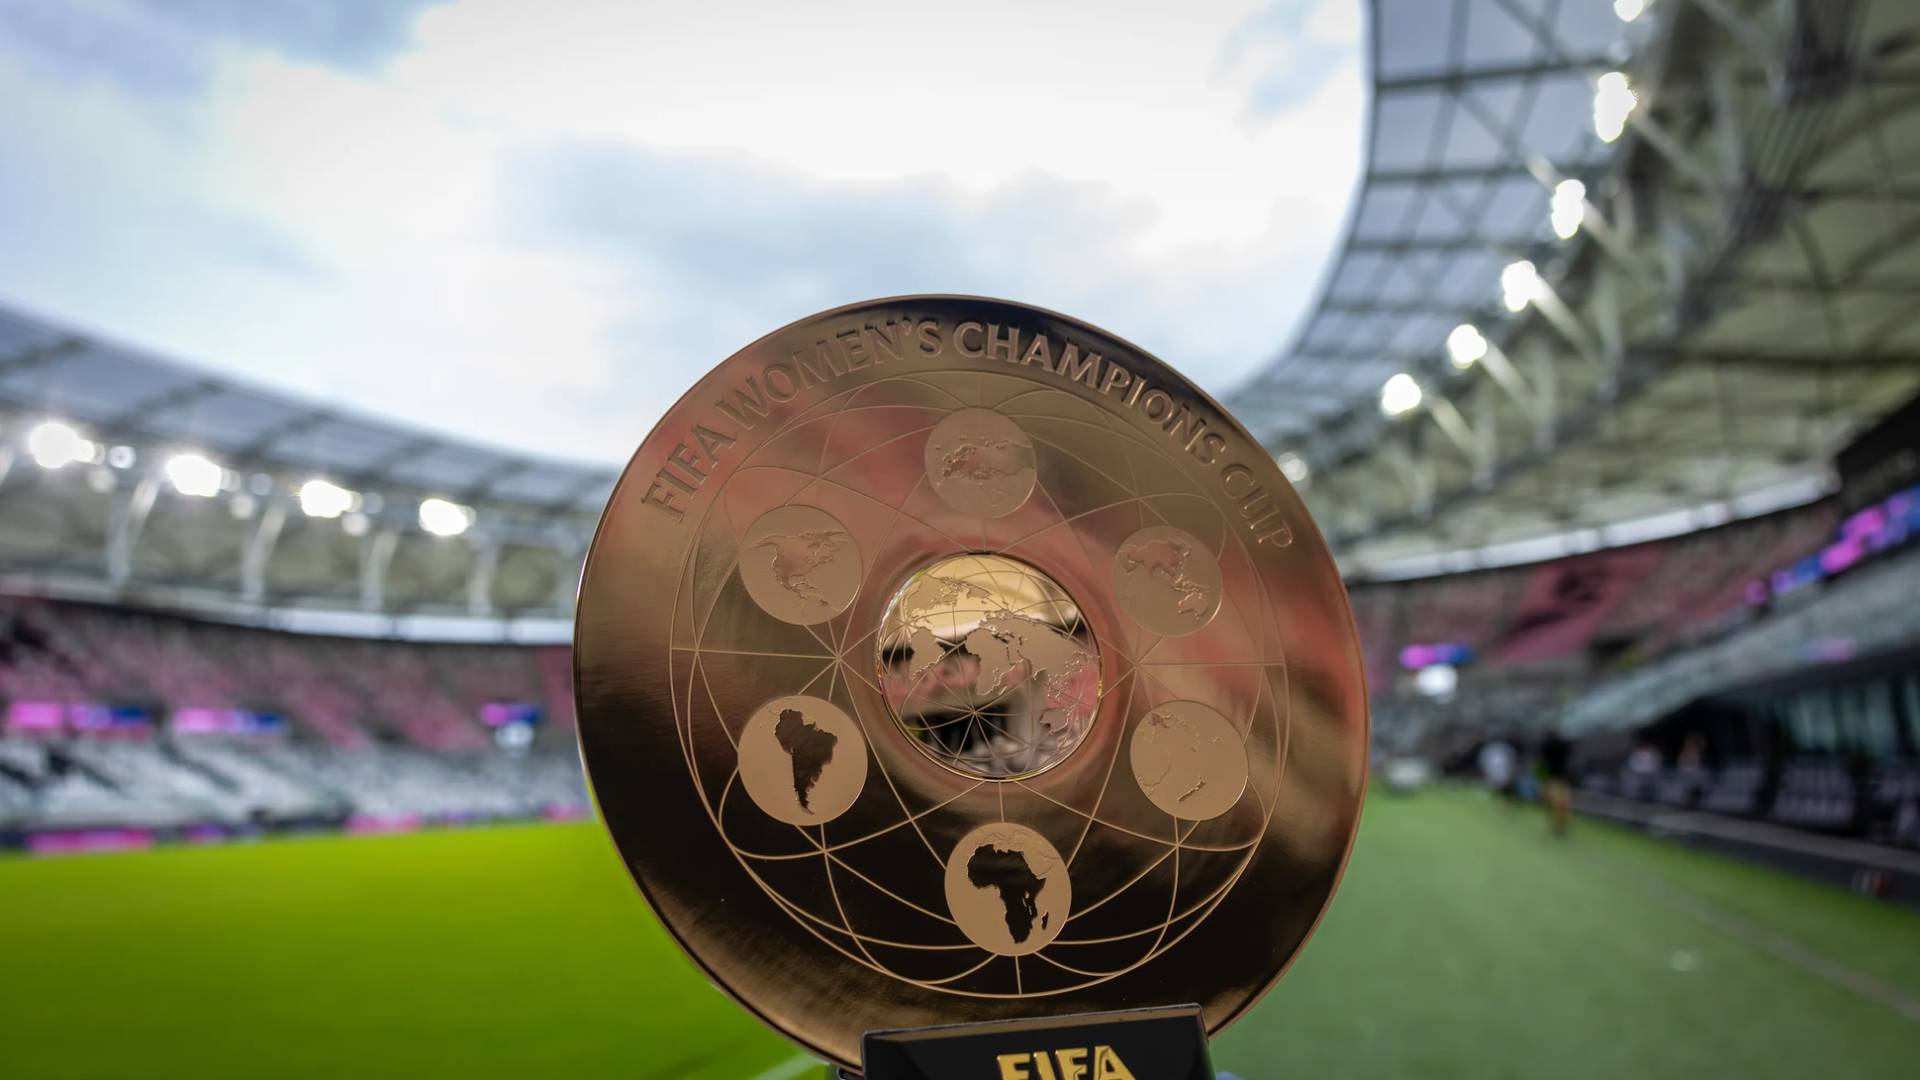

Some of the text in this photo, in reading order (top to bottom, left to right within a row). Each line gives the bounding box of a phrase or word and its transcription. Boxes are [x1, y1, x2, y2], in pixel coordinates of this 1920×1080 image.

[641, 318, 1293, 548] FIFA WOMEN'S CHAMPIONS CUP
[997, 1045, 1136, 1080] FIFA
